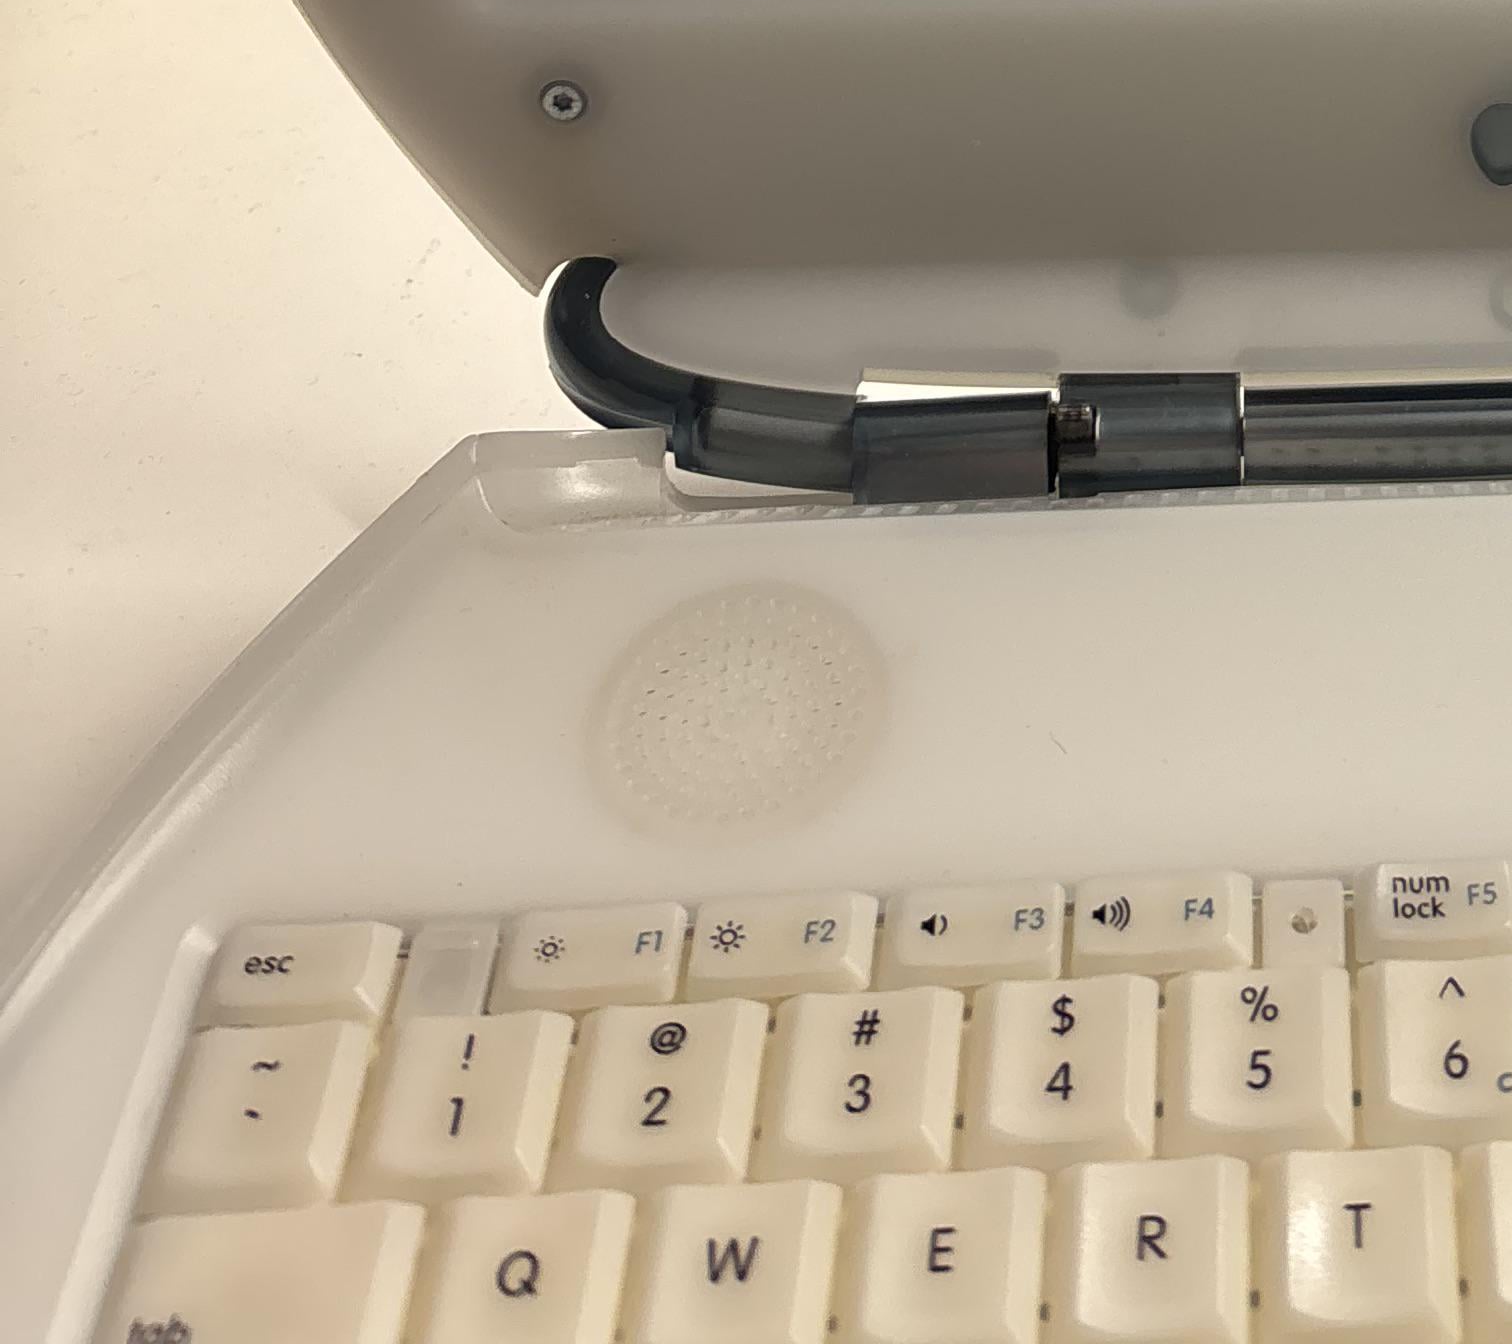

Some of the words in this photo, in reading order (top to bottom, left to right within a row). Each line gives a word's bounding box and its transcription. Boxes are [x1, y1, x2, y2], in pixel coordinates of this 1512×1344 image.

[1391, 873, 1450, 895] num
[1466, 880, 1498, 906] F5
[1013, 907, 1046, 932] F3
[1183, 896, 1216, 922] F4
[1391, 896, 1446, 920] lock
[634, 929, 664, 955] F1
[803, 918, 837, 945] F2
[243, 950, 294, 976] esc
[1245, 1049, 1274, 1090] 5
[1443, 1040, 1470, 1080] 6
[844, 1073, 872, 1114] 3
[1045, 1061, 1074, 1101] 4
[448, 1097, 465, 1137] 1
[641, 1086, 672, 1127] 2
[1135, 1214, 1169, 1261] R
[1343, 1202, 1372, 1249] T
[706, 1236, 760, 1283] W
[927, 1225, 957, 1273] E
[495, 1249, 541, 1299] Q
